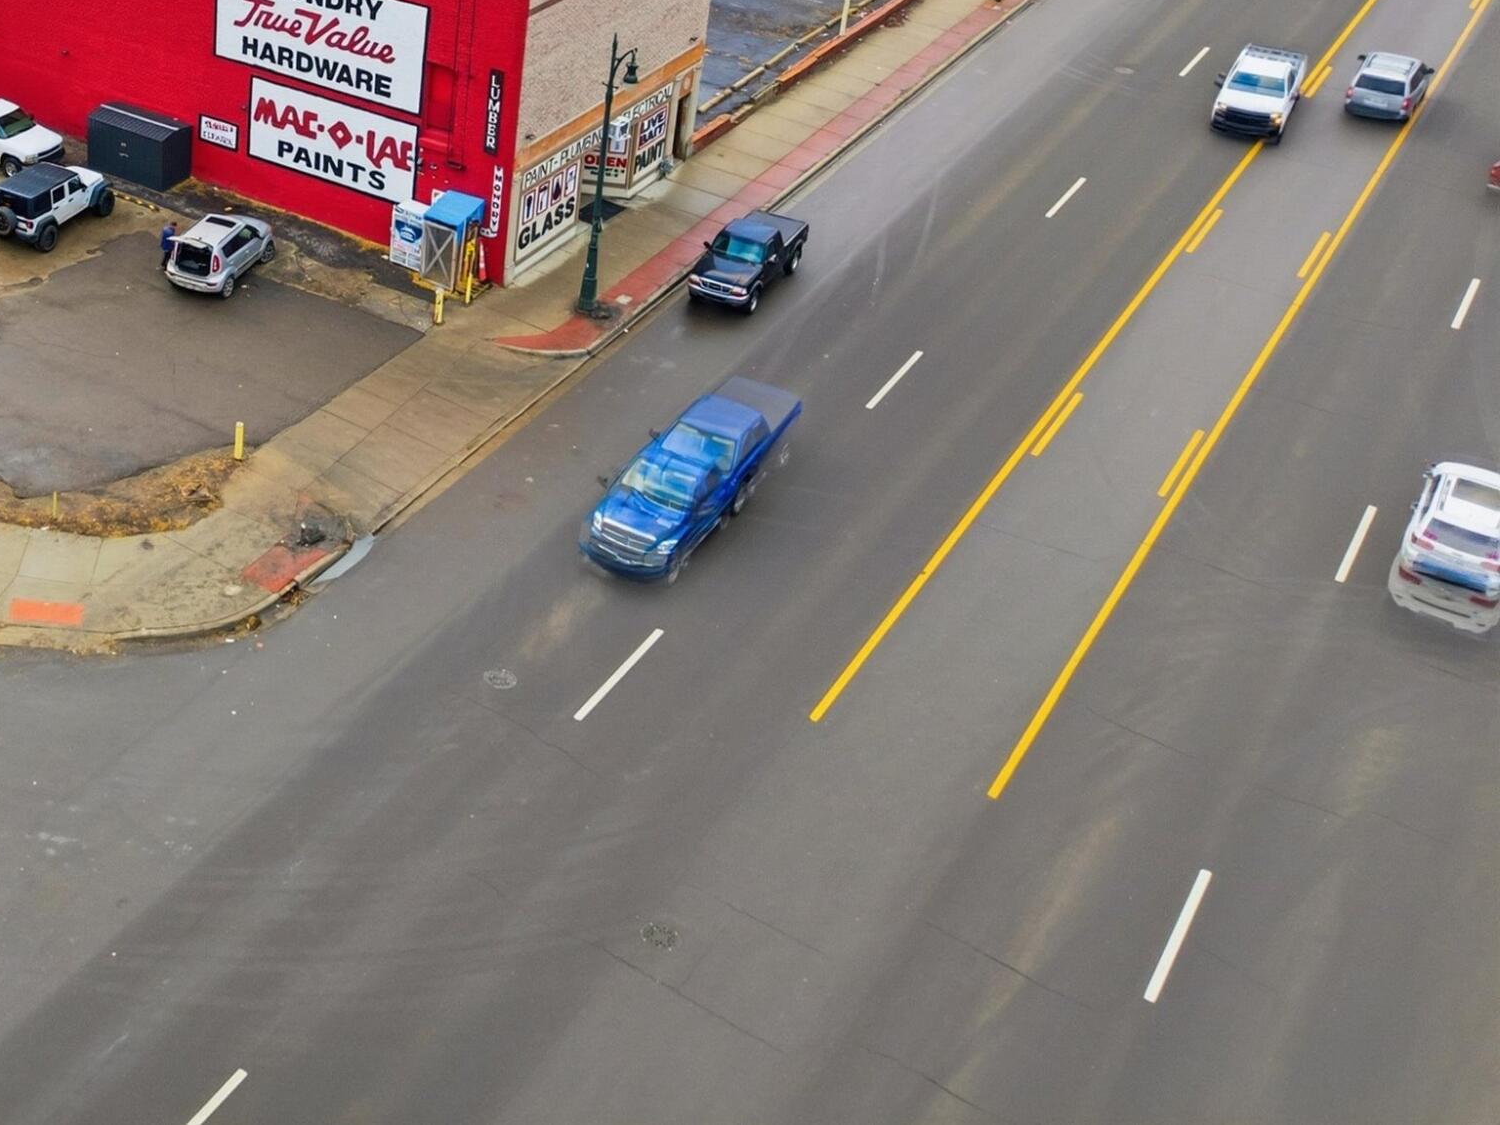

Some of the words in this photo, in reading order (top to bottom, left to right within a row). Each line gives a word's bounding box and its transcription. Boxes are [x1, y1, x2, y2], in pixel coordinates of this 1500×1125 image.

[294, 8, 396, 65] Value
[242, 36, 393, 98] HARDWARE
[486, 75, 501, 149] LUMBER
[639, 123, 665, 147] BAIT
[641, 110, 666, 132] LIVE
[277, 140, 386, 191] PAINTS
[634, 139, 665, 175] PAINT
[518, 196, 575, 250] GLASS
